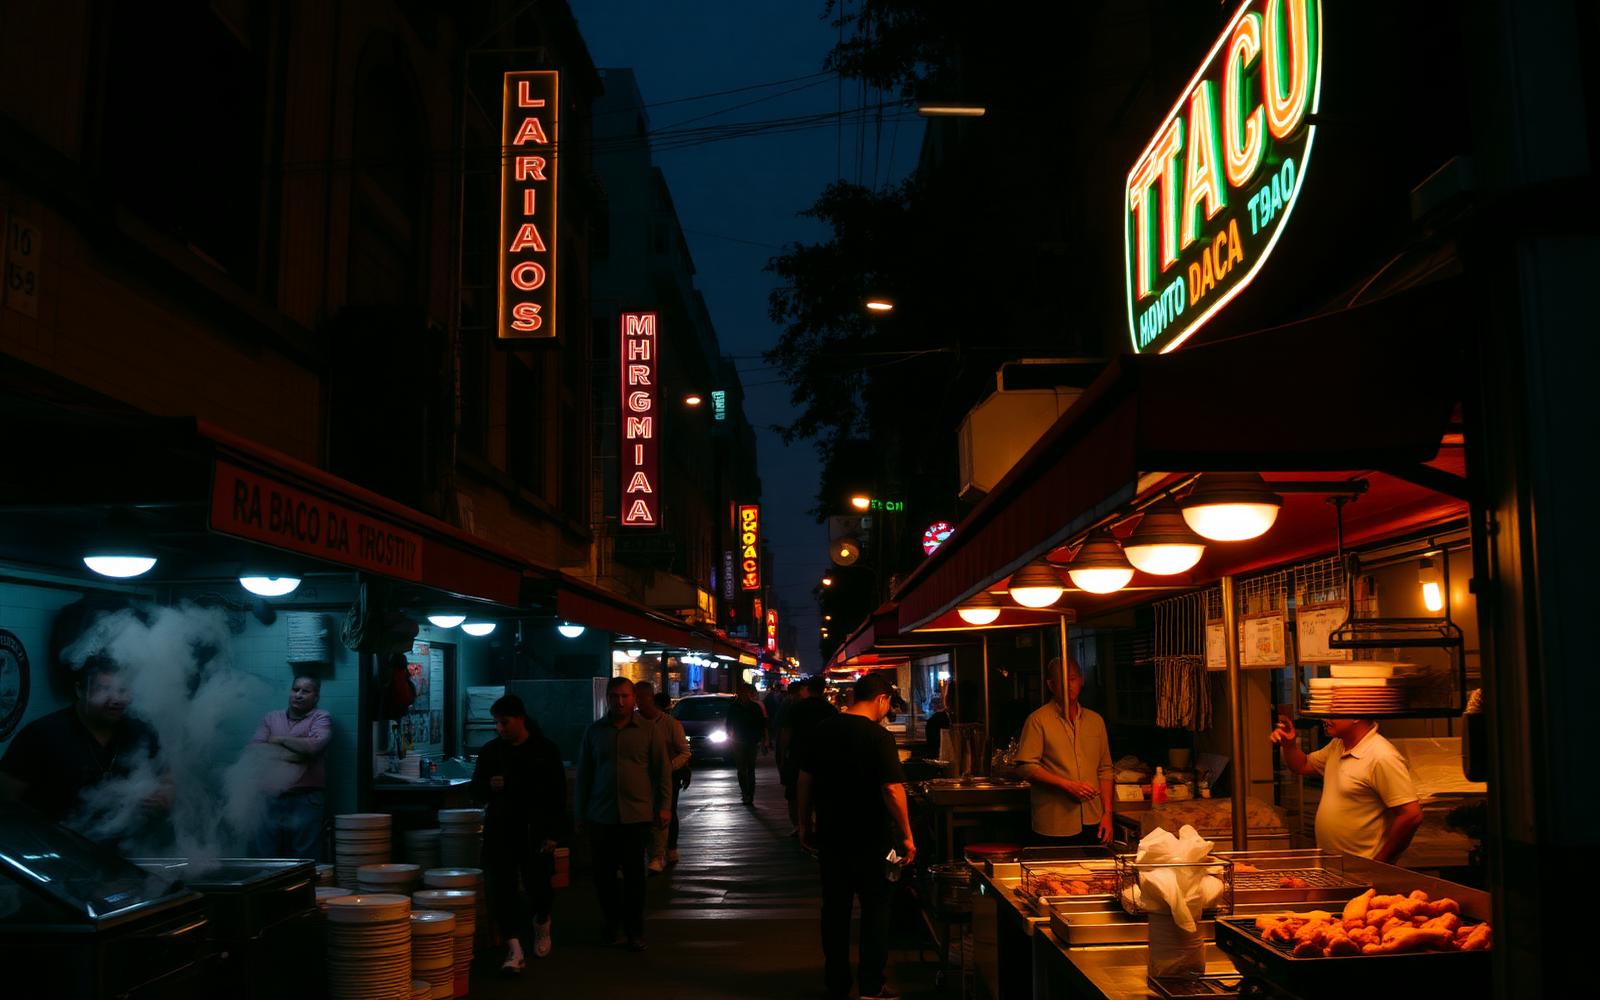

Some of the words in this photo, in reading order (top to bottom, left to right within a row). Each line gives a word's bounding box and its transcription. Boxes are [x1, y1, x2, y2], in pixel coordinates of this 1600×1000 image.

[509, 80, 546, 332] LARIAOS
[1189, 219, 1244, 307] DACA
[626, 315, 654, 522] MHRGMIAA
[234, 479, 263, 528] RA
[270, 491, 319, 545] BACO
[327, 511, 349, 553] DA
